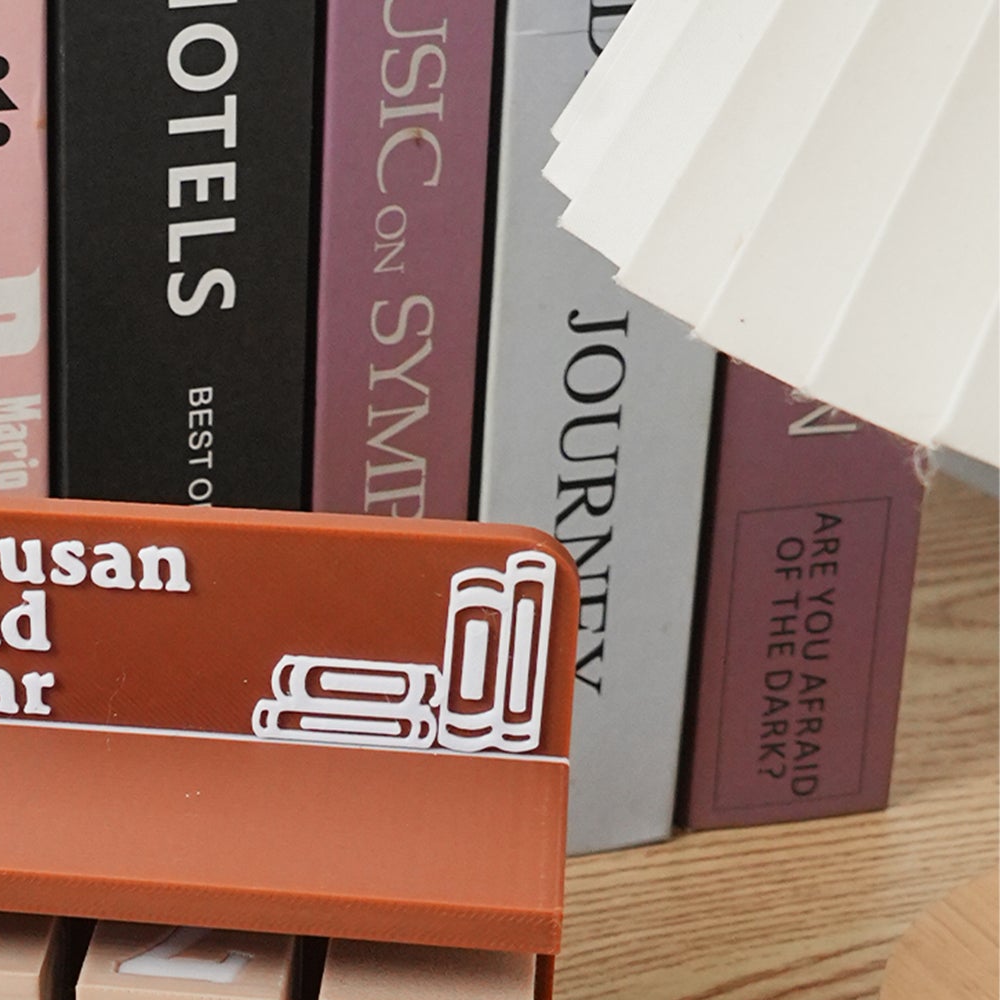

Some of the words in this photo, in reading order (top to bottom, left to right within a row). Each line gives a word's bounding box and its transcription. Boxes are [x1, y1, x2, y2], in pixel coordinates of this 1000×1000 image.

[372, 204, 407, 275] ON
[188, 386, 214, 470] BEST
[187, 477, 214, 507] O
[774, 536, 806, 581] OF
[808, 511, 843, 579] ARE
[766, 591, 801, 659] THE
[801, 587, 837, 661] YOU
[757, 669, 794, 780] DARK?
[790, 673, 828, 797] AFRAID
